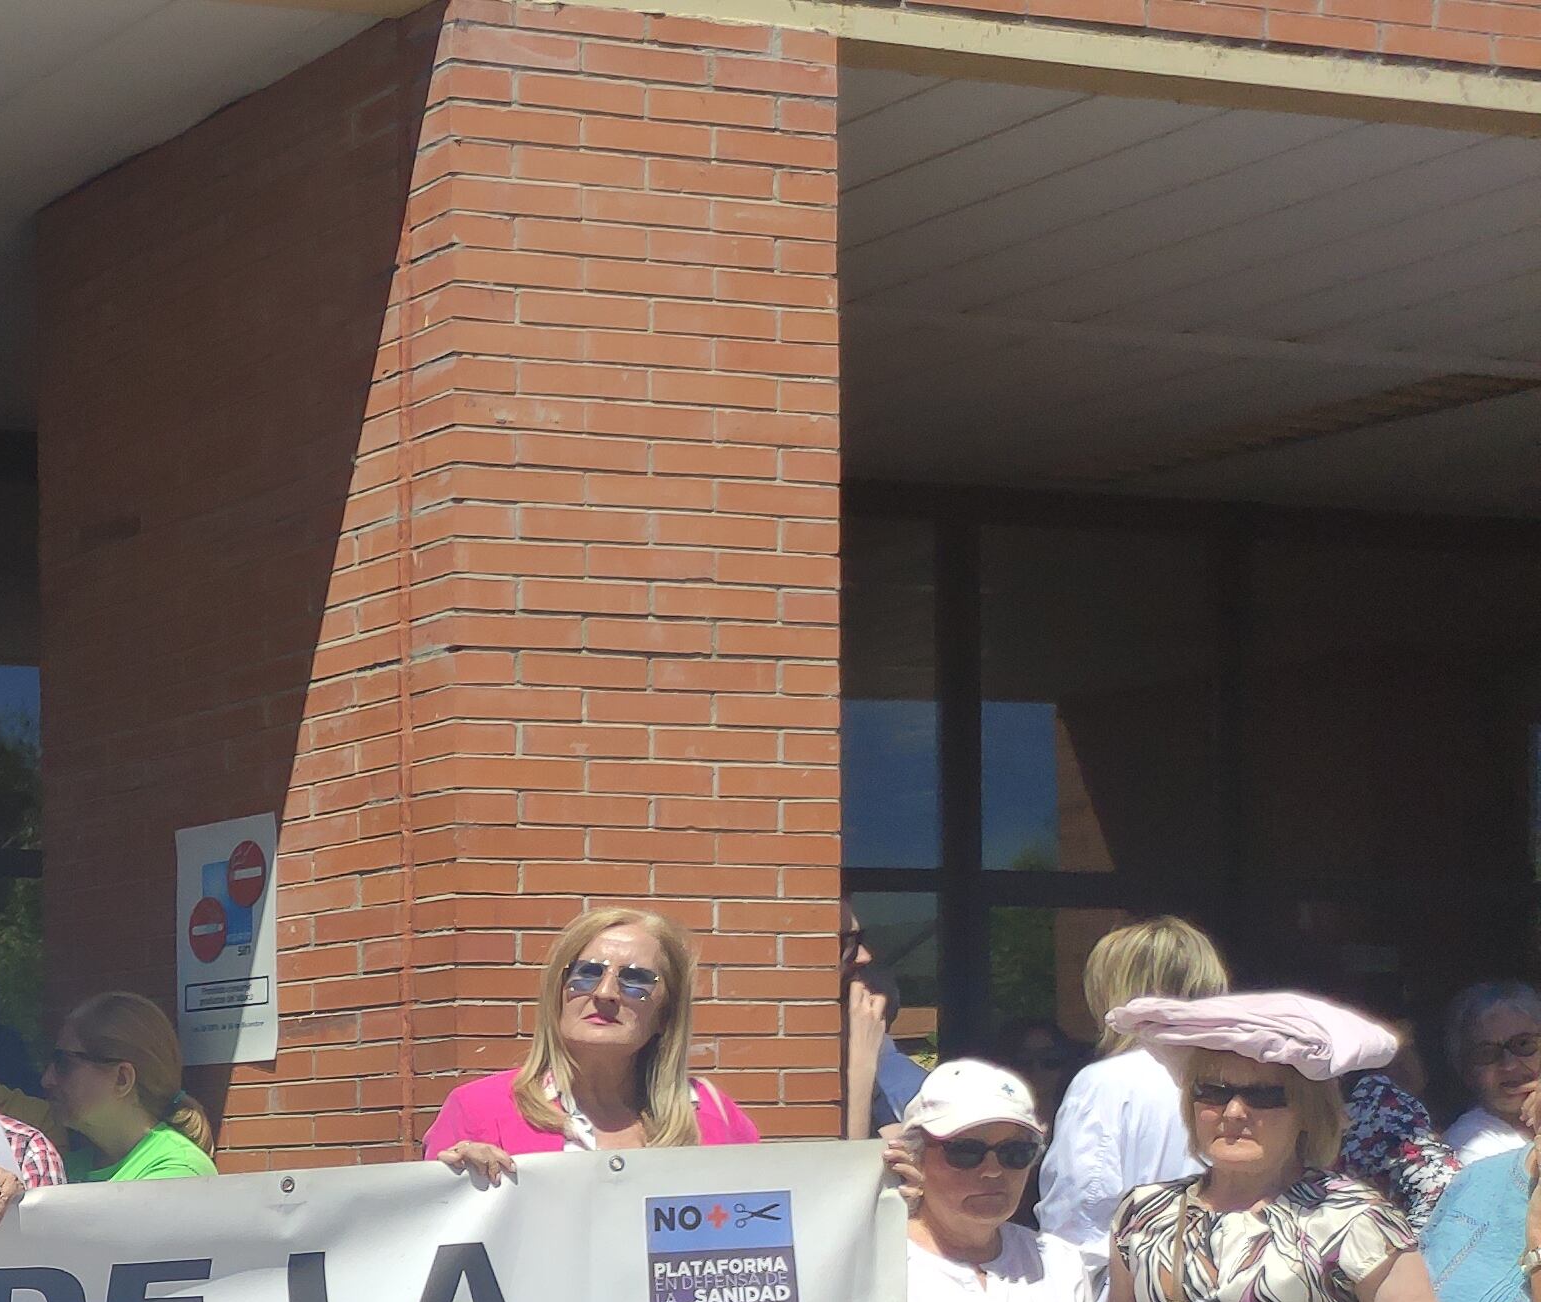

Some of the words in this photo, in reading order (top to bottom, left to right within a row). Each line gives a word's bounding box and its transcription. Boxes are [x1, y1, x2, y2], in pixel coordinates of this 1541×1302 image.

[654, 1256, 789, 1278] PLATAFORMA
[655, 1277, 677, 1291] EN
[683, 1273, 761, 1290] DEFENSA
[766, 1273, 788, 1285] DE
